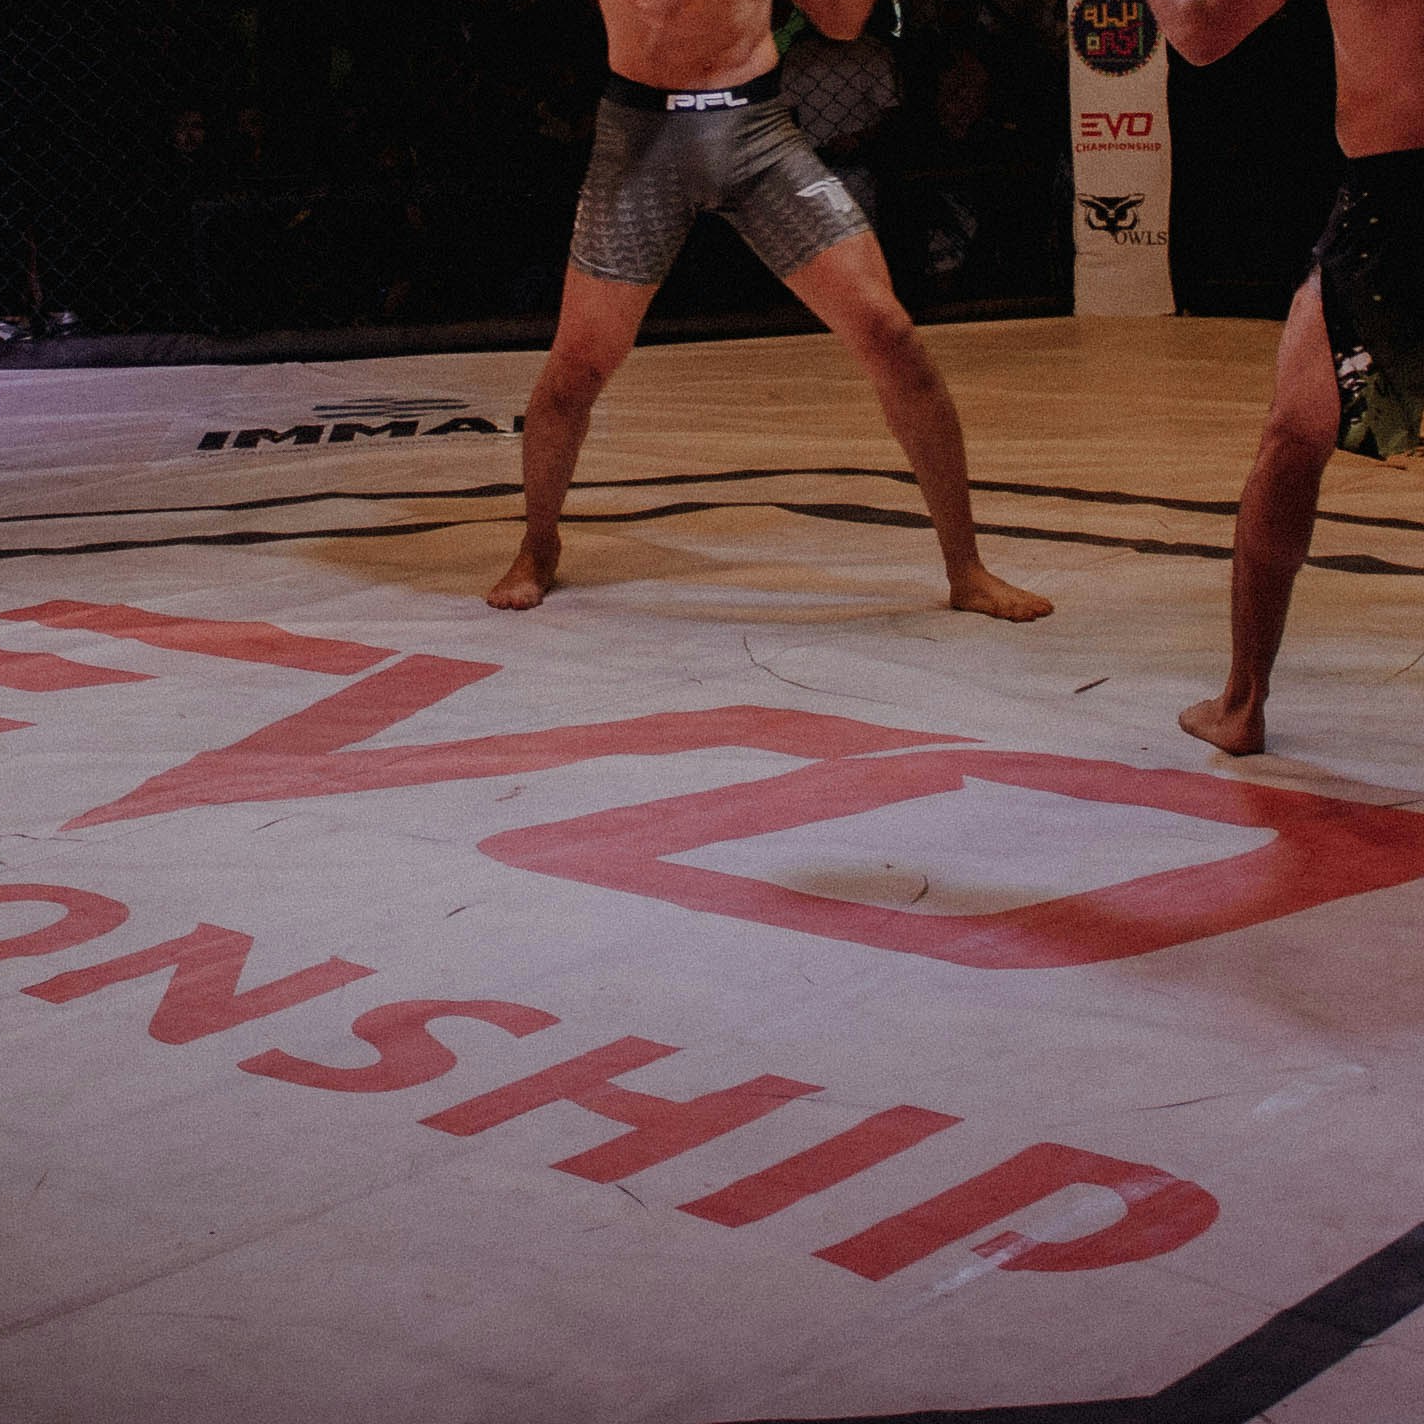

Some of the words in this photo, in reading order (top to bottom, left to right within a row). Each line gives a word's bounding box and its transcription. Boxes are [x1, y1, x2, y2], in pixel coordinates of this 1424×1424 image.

[665, 91, 749, 112] PFL
[1081, 113, 1153, 140] EVO
[1076, 142, 1162, 153] CHAMPIONSHIP
[1114, 231, 1168, 246] OWLS
[196, 414, 527, 450] IMMA
